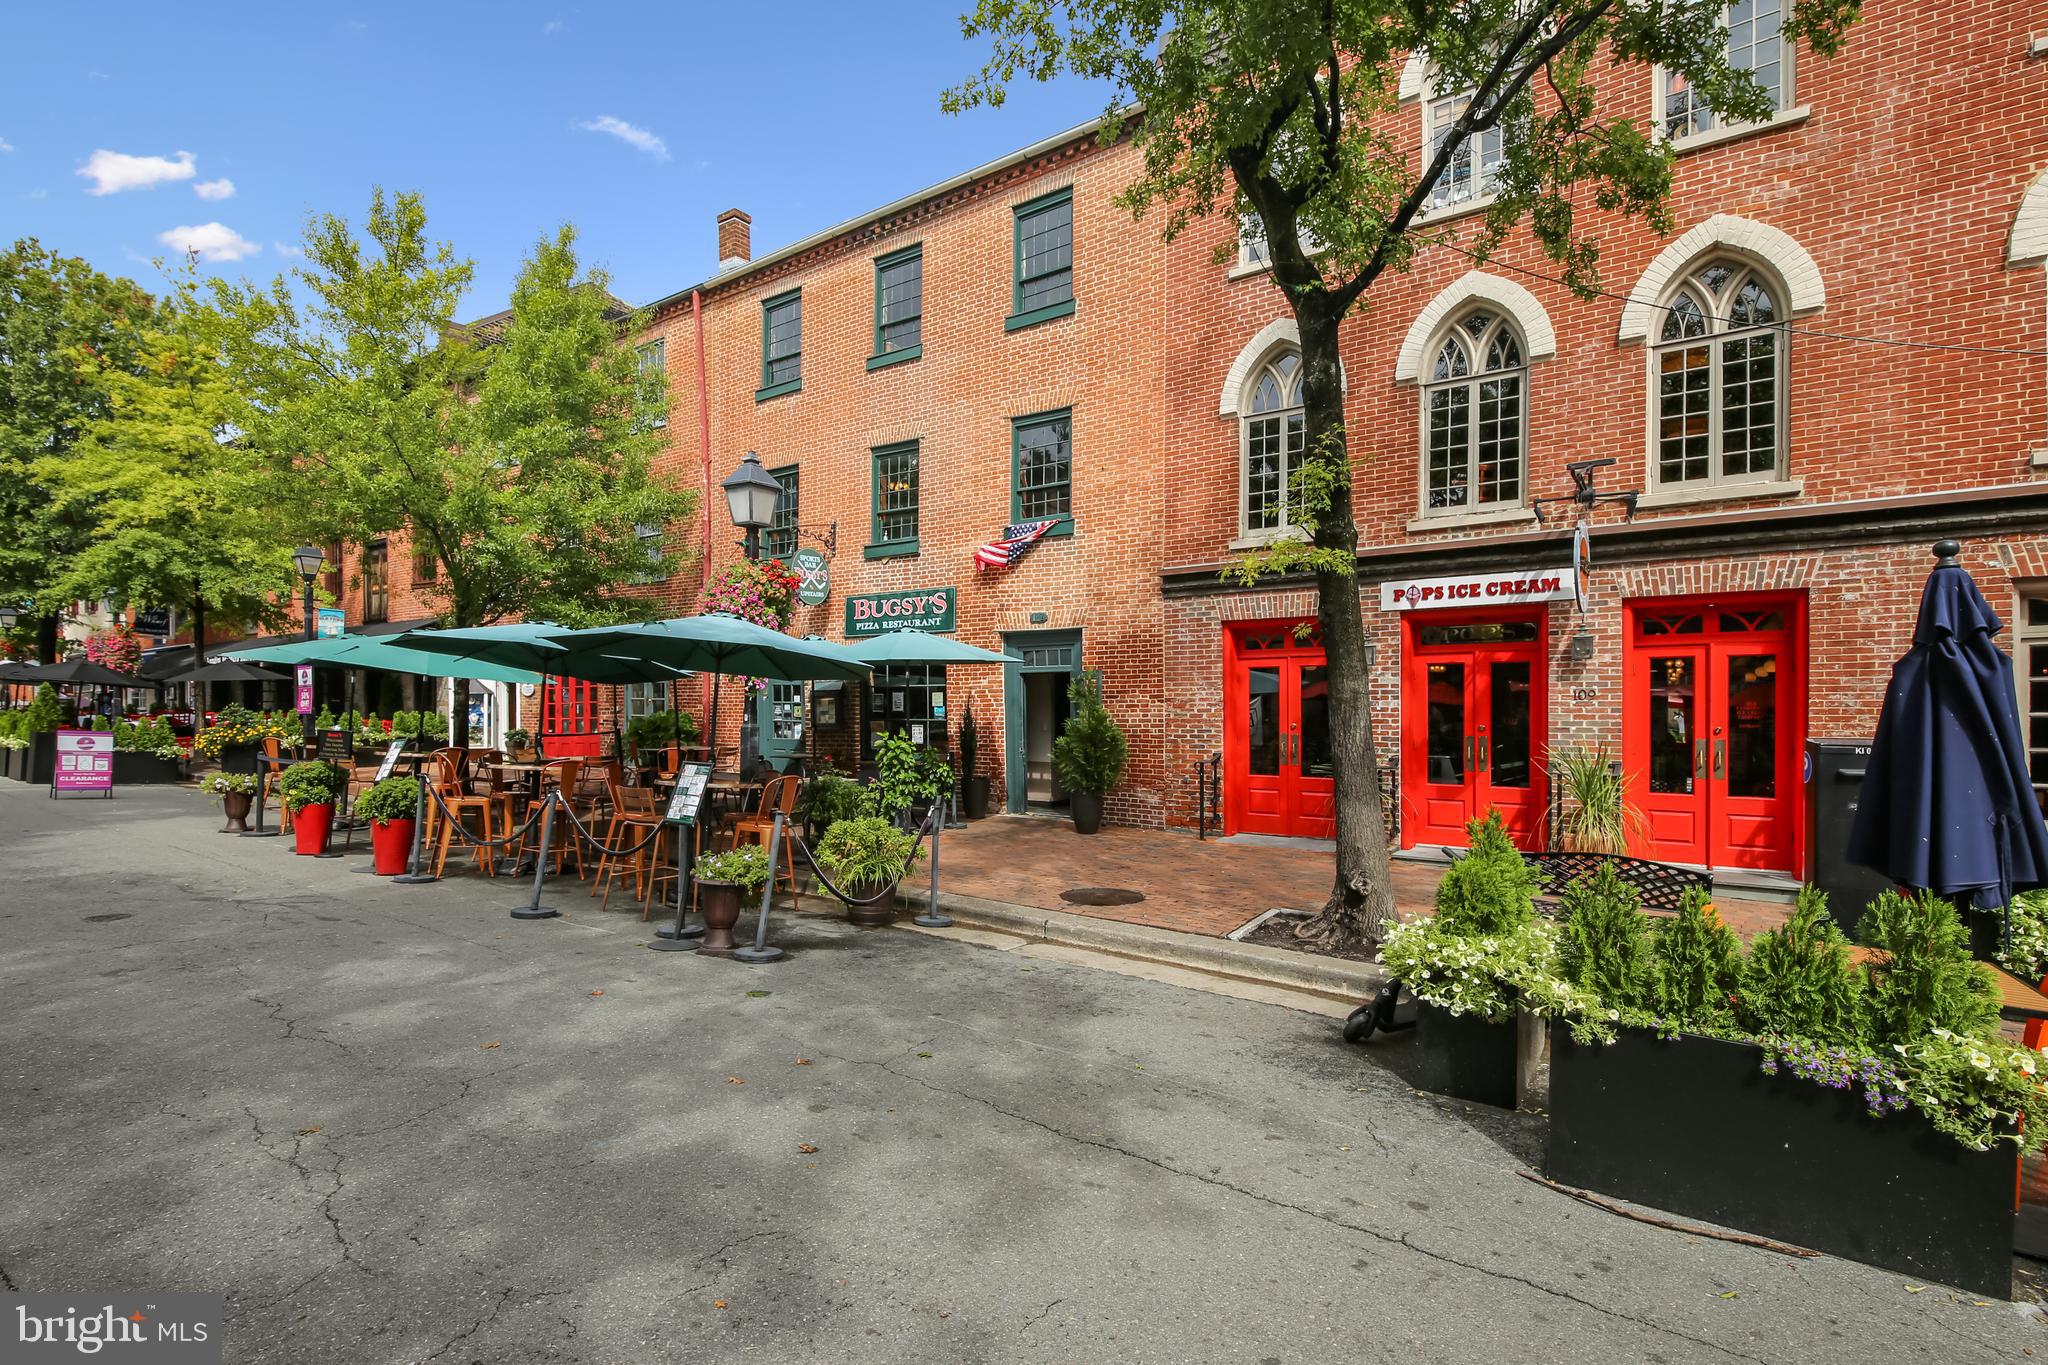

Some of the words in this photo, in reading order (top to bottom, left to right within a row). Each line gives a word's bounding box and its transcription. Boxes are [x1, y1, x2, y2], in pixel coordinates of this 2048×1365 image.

[1448, 583, 1481, 600] ICE
[1486, 577, 1561, 596] CREAM
[853, 592, 947, 620] BUGSY'S
[856, 622, 879, 630] PIZZA
[882, 618, 942, 629] RESTAURANT
[1573, 689, 1596, 701] 109
